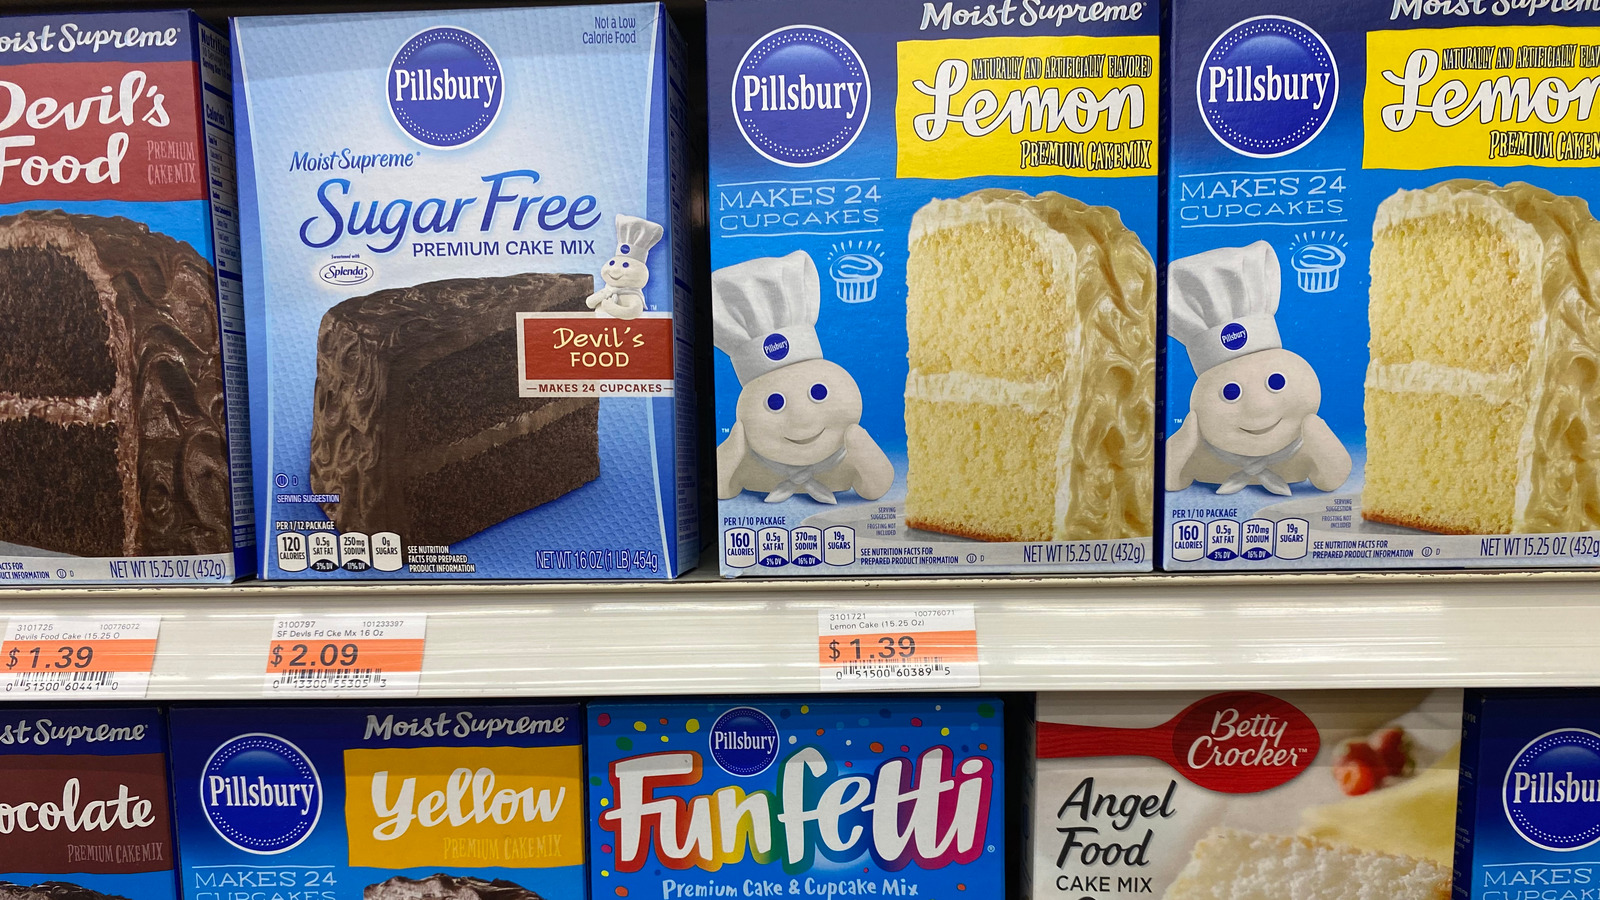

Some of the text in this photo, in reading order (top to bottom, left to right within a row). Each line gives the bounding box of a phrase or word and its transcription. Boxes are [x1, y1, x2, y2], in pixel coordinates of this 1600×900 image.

[595, 16, 635, 29] Not a Low
[920, 0, 1142, 30] Moist Supreme
[0, 25, 56, 52] oist
[58, 23, 177, 53] Supreme
[583, 31, 636, 44] Calorie Food
[971, 54, 1152, 80] NATURALLY AND ARTIFICIALLY FLAVORED
[395, 69, 497, 108] Pillsbury
[743, 74, 862, 119] Pillsbury
[1208, 65, 1330, 109] Pillsbury
[0, 70, 170, 131] Devil's
[912, 59, 1145, 141] Lemon
[147, 140, 195, 161] PREMIUM
[1020, 140, 1086, 169] PREMIUM
[1489, 130, 1554, 159] PREMIUM
[0, 132, 129, 186] Food
[289, 148, 413, 174] Moist Supreme
[719, 185, 881, 211] MAKES 24
[1180, 176, 1346, 201] MAKES 24
[299, 178, 477, 252] Sugar
[480, 170, 602, 232] Free
[720, 209, 880, 231] CUPCAKES
[1180, 199, 1343, 221] CUPCAKES
[414, 240, 595, 257] PREMIUM CAKE MIX
[324, 266, 364, 279] Splenda
[553, 327, 644, 349] Devil's
[765, 340, 787, 354] Pillsbury
[570, 352, 630, 367] FOOD
[539, 384, 662, 392] MAKES 24 CUPCAKES
[276, 522, 334, 530] PER 1/12 PACKAGE
[724, 517, 786, 525] PER 1/10 PACKAGE
[282, 537, 300, 551] 120
[731, 533, 749, 547] 160
[766, 532, 780, 543] 0.5g
[795, 542, 817, 550] SODIUM
[834, 531, 844, 541] 19g
[1480, 537, 1567, 556] NET WT 15.25 OZ
[280, 552, 305, 560] CALORIES
[536, 549, 658, 572] NET WT 16 OZ (1 LB) 454g
[727, 548, 754, 556] CALORIES
[860, 548, 870, 556] SEE
[872, 548, 902, 556] NUTRITION
[860, 557, 890, 565] PREPARED
[919, 556, 958, 564] INFORMATION
[1024, 543, 1145, 564] NET WT 15.25 OZ (432g)
[110, 560, 226, 580] NET WT 15.25 OZ (432g)
[882, 620, 908, 628] (15.25
[15, 632, 38, 640] Devils
[40, 632, 60, 640] Food
[63, 632, 81, 640] Cake
[84, 632, 111, 640] (15.25
[34, 719, 145, 746] Supreme
[363, 712, 565, 740] Moist Supreme
[1211, 708, 1288, 747] Betty
[714, 731, 775, 755] Pillsbury
[1188, 735, 1298, 769] Crocker
[209, 776, 314, 815] Pillsbury
[1513, 771, 1600, 803] Pillsbu
[0, 778, 155, 834] ocolate
[372, 767, 565, 840] Yellow
[604, 746, 984, 865] Funfetti
[1057, 777, 1177, 830] Angel
[68, 844, 112, 862] PREMIUM
[443, 838, 499, 860] PREMIUM
[1056, 827, 1153, 869] Food
[196, 871, 337, 888] MAKES 24
[663, 877, 918, 900] Premium Cake & Cupcake Mix
[1056, 875, 1152, 893] CAKE MIX
[1484, 868, 1592, 887] MAKES
